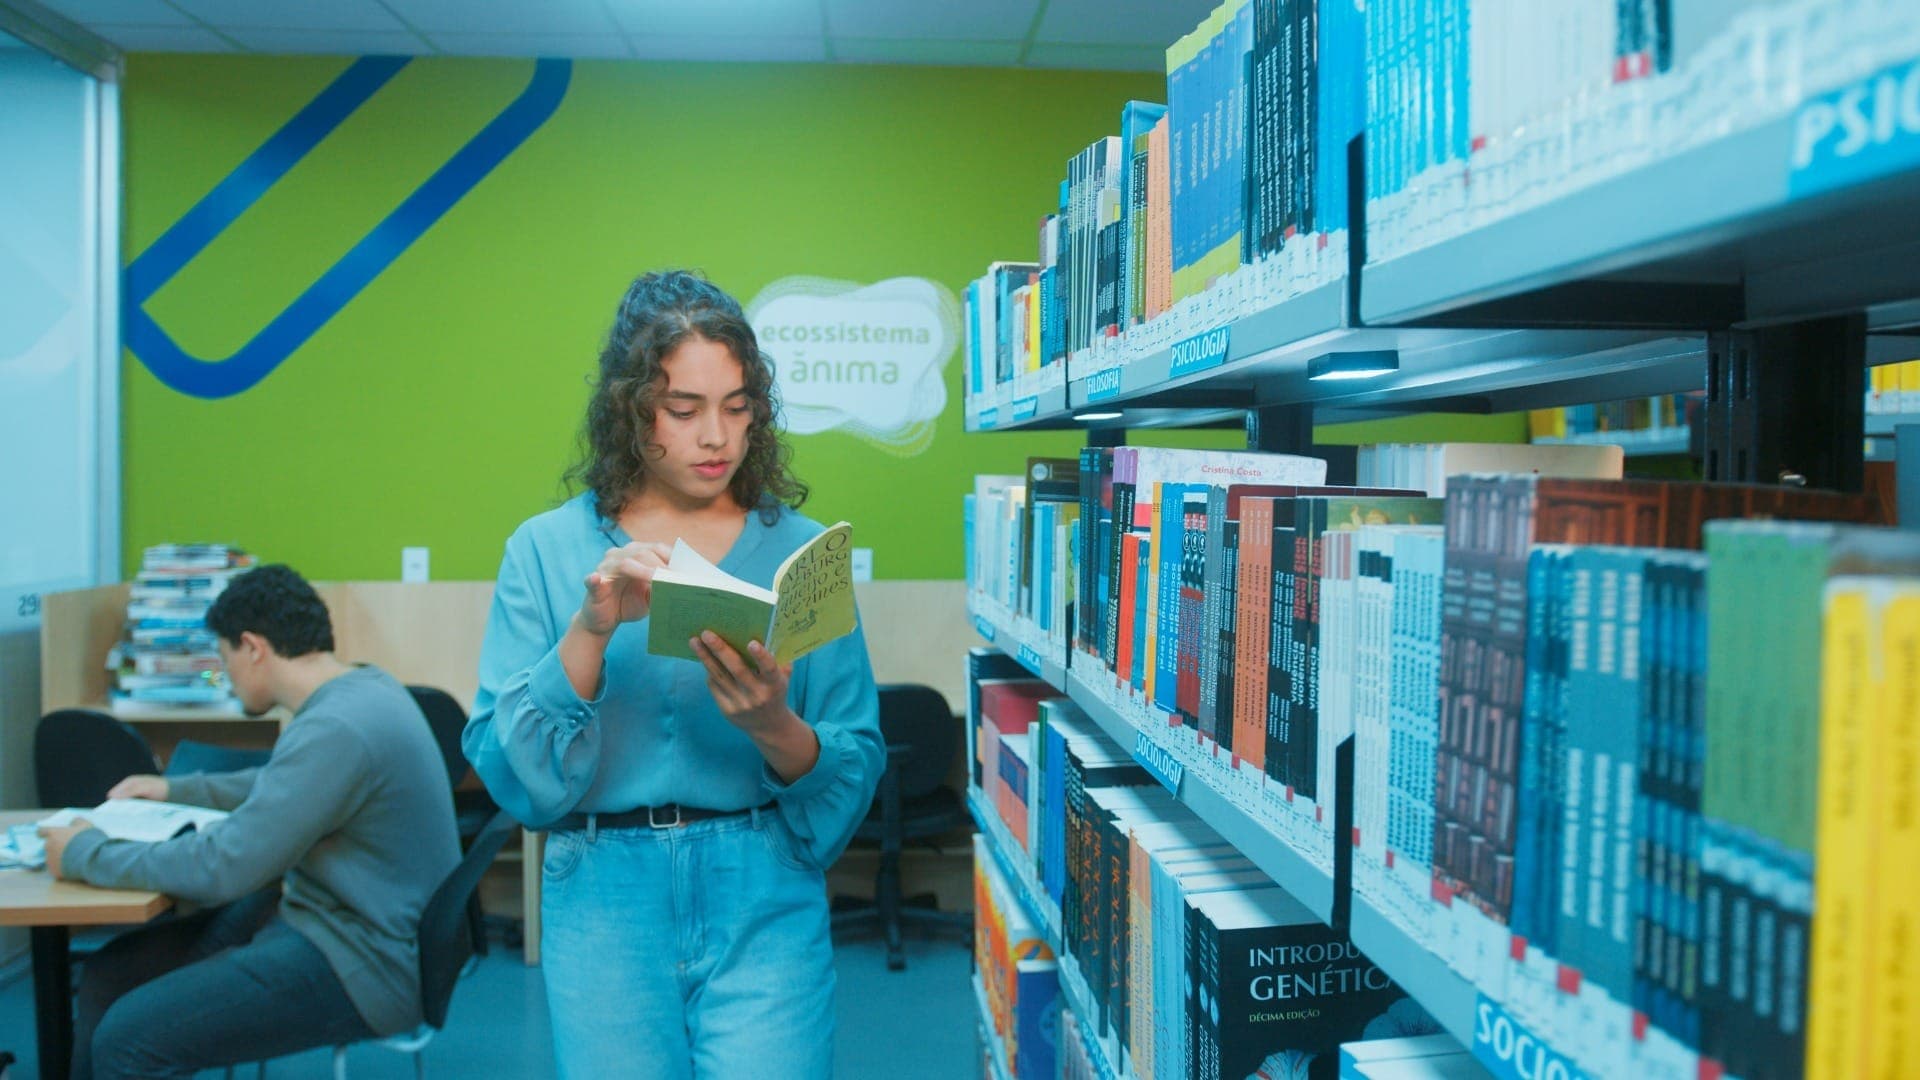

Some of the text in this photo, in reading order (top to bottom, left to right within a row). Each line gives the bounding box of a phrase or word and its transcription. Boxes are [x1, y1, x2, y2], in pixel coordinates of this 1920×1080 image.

[761, 322, 931, 344] ecossistema
[1171, 328, 1228, 368] PSICOLOGIA
[1201, 464, 1262, 477] Cristina Costa
[1291, 640, 1299, 702] violência
[1298, 642, 1306, 706] violência
[1309, 646, 1317, 710] violência
[1250, 1008, 1320, 1023] DÉCIMA EDIÇÃO
